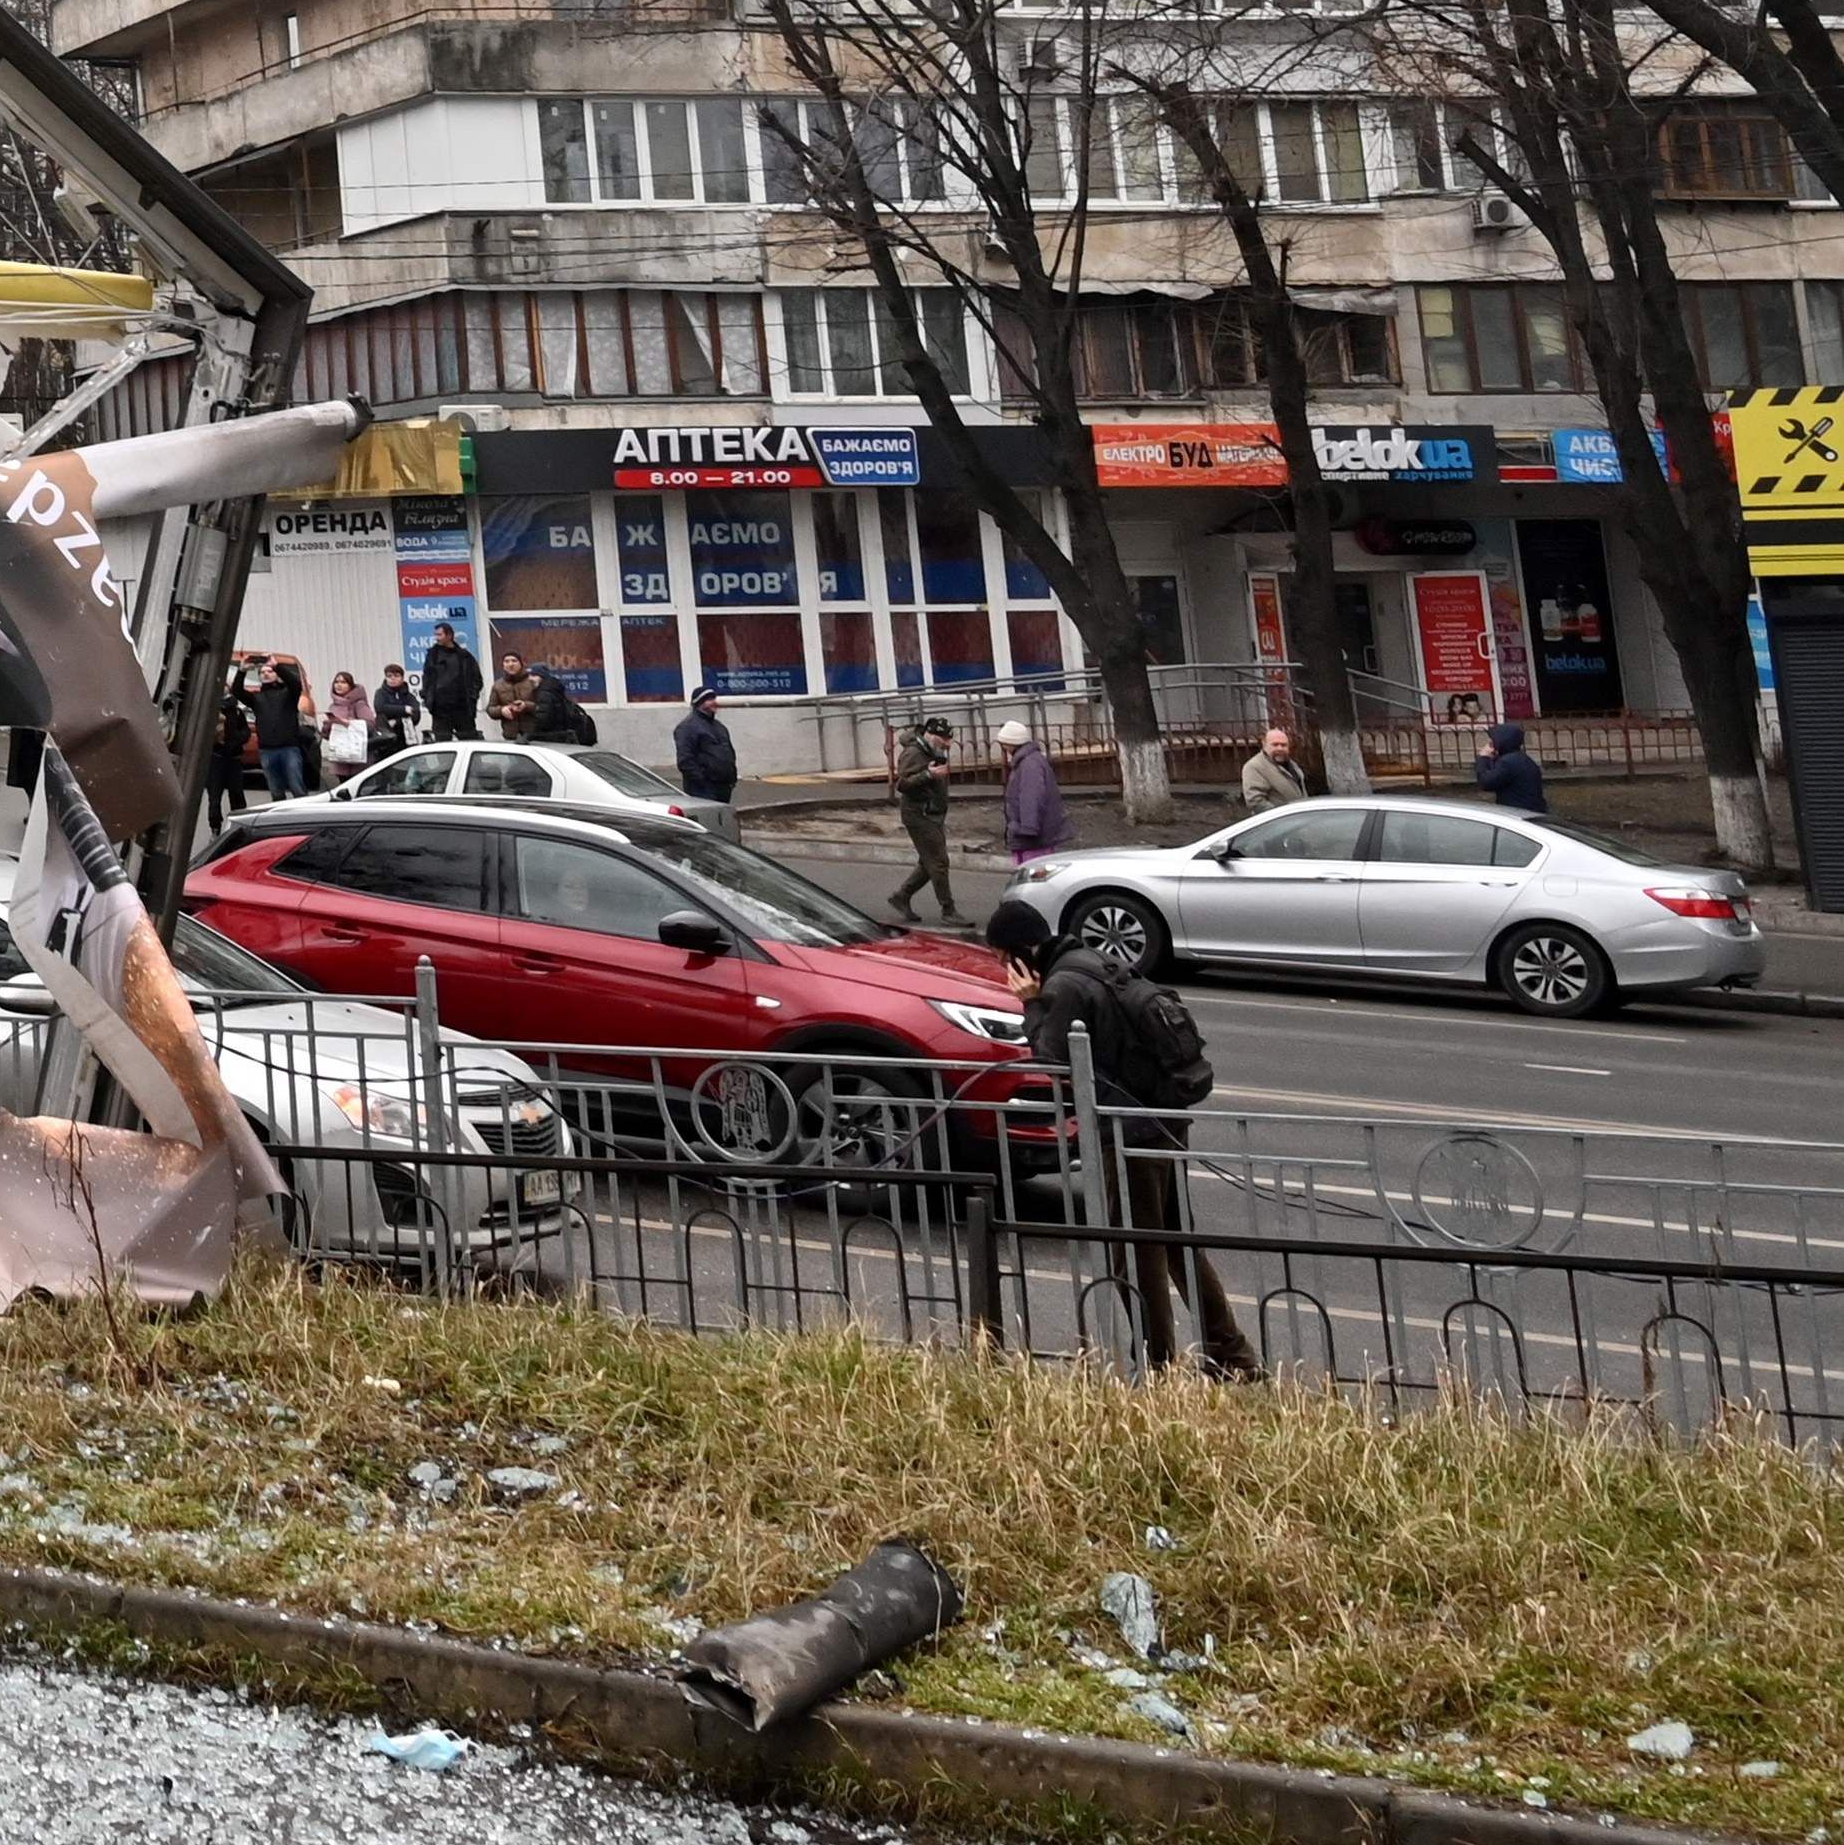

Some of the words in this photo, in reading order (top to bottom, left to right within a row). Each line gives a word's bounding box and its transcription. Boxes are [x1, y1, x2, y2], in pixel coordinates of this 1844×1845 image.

[613, 427, 811, 463] АПТЕКА
[822, 438, 911, 452] БАЖАЄМО
[1102, 444, 1166, 464] ЕЛЕКТРО
[1168, 442, 1214, 468] БУД
[830, 460, 913, 476] ЗДОРОВ'Я
[650, 471, 699, 485] 8.00
[731, 471, 791, 484] 21.00
[275, 510, 387, 536] ОРЕНДА
[396, 536, 429, 547] ВОДА
[401, 576, 435, 588] Студія
[437, 577, 468, 587] краси
[541, 618, 600, 628] МЕРЕЖА
[621, 617, 664, 627] АПТЕК
